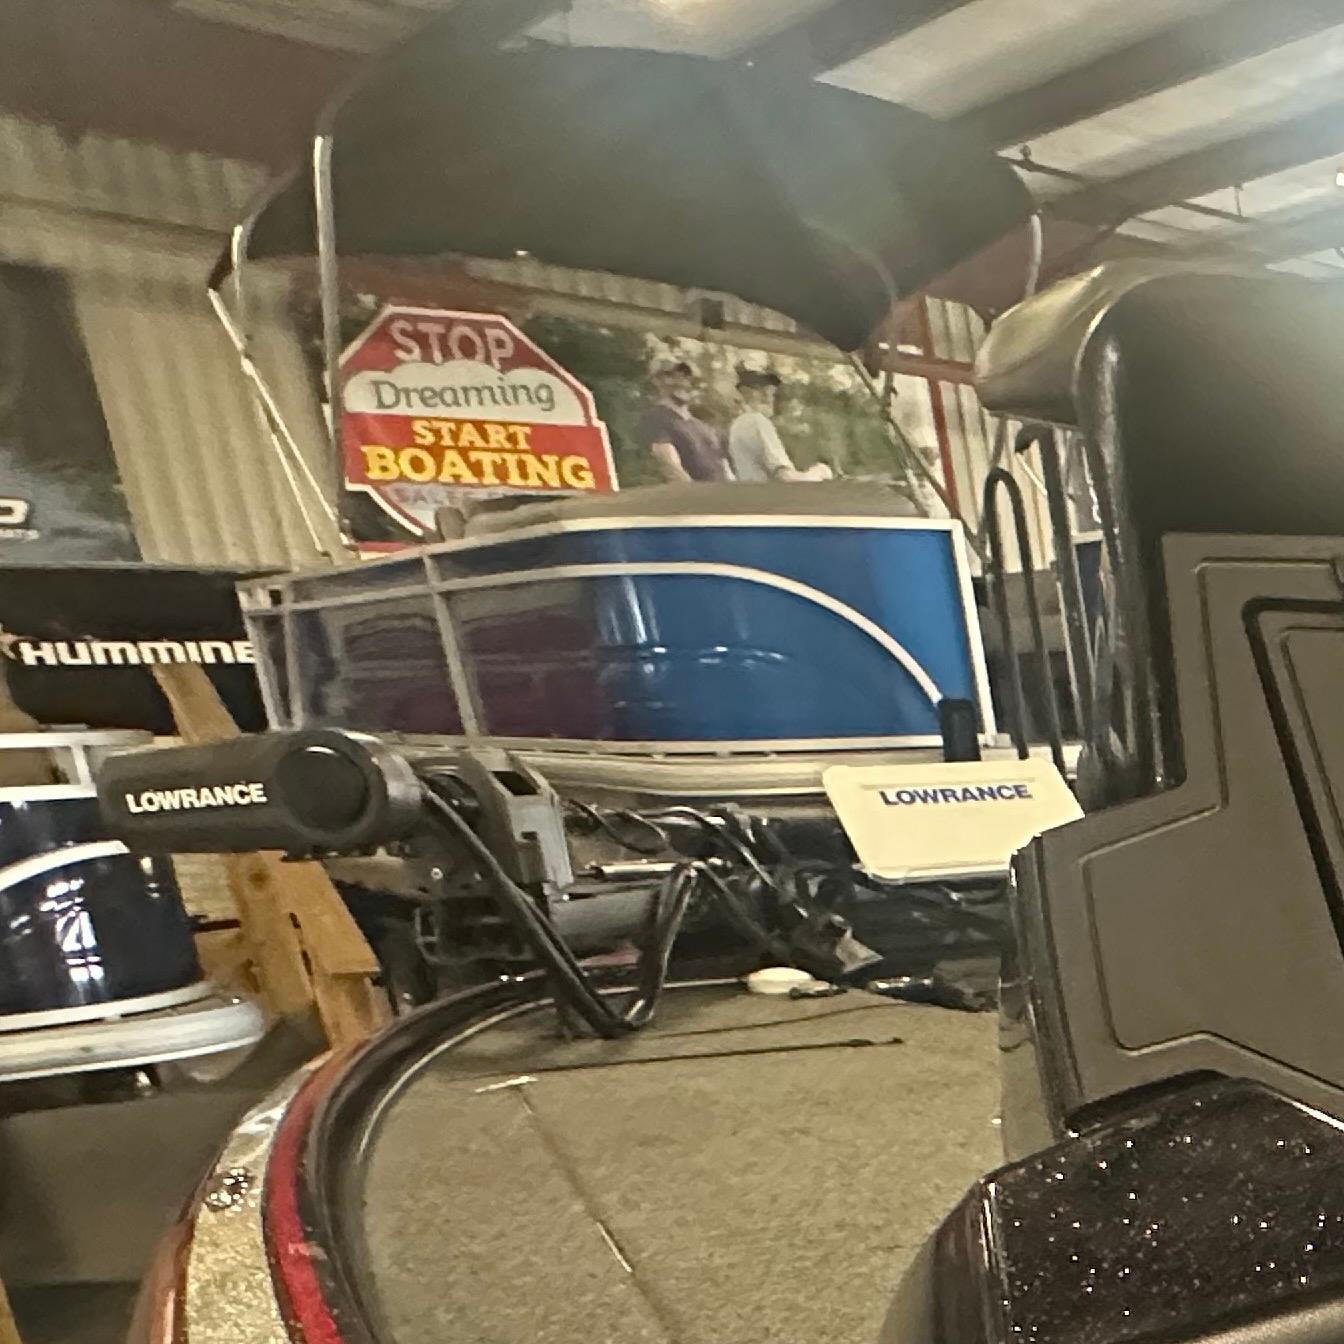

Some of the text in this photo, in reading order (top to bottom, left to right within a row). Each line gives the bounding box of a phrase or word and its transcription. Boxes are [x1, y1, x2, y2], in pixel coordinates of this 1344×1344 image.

[388, 319, 514, 370] STOP
[371, 377, 556, 411] Dreaming
[411, 420, 532, 449] START
[361, 445, 595, 489] BOATING
[125, 783, 267, 814] LOWRANCE
[878, 784, 1033, 806] LOWRANCE
